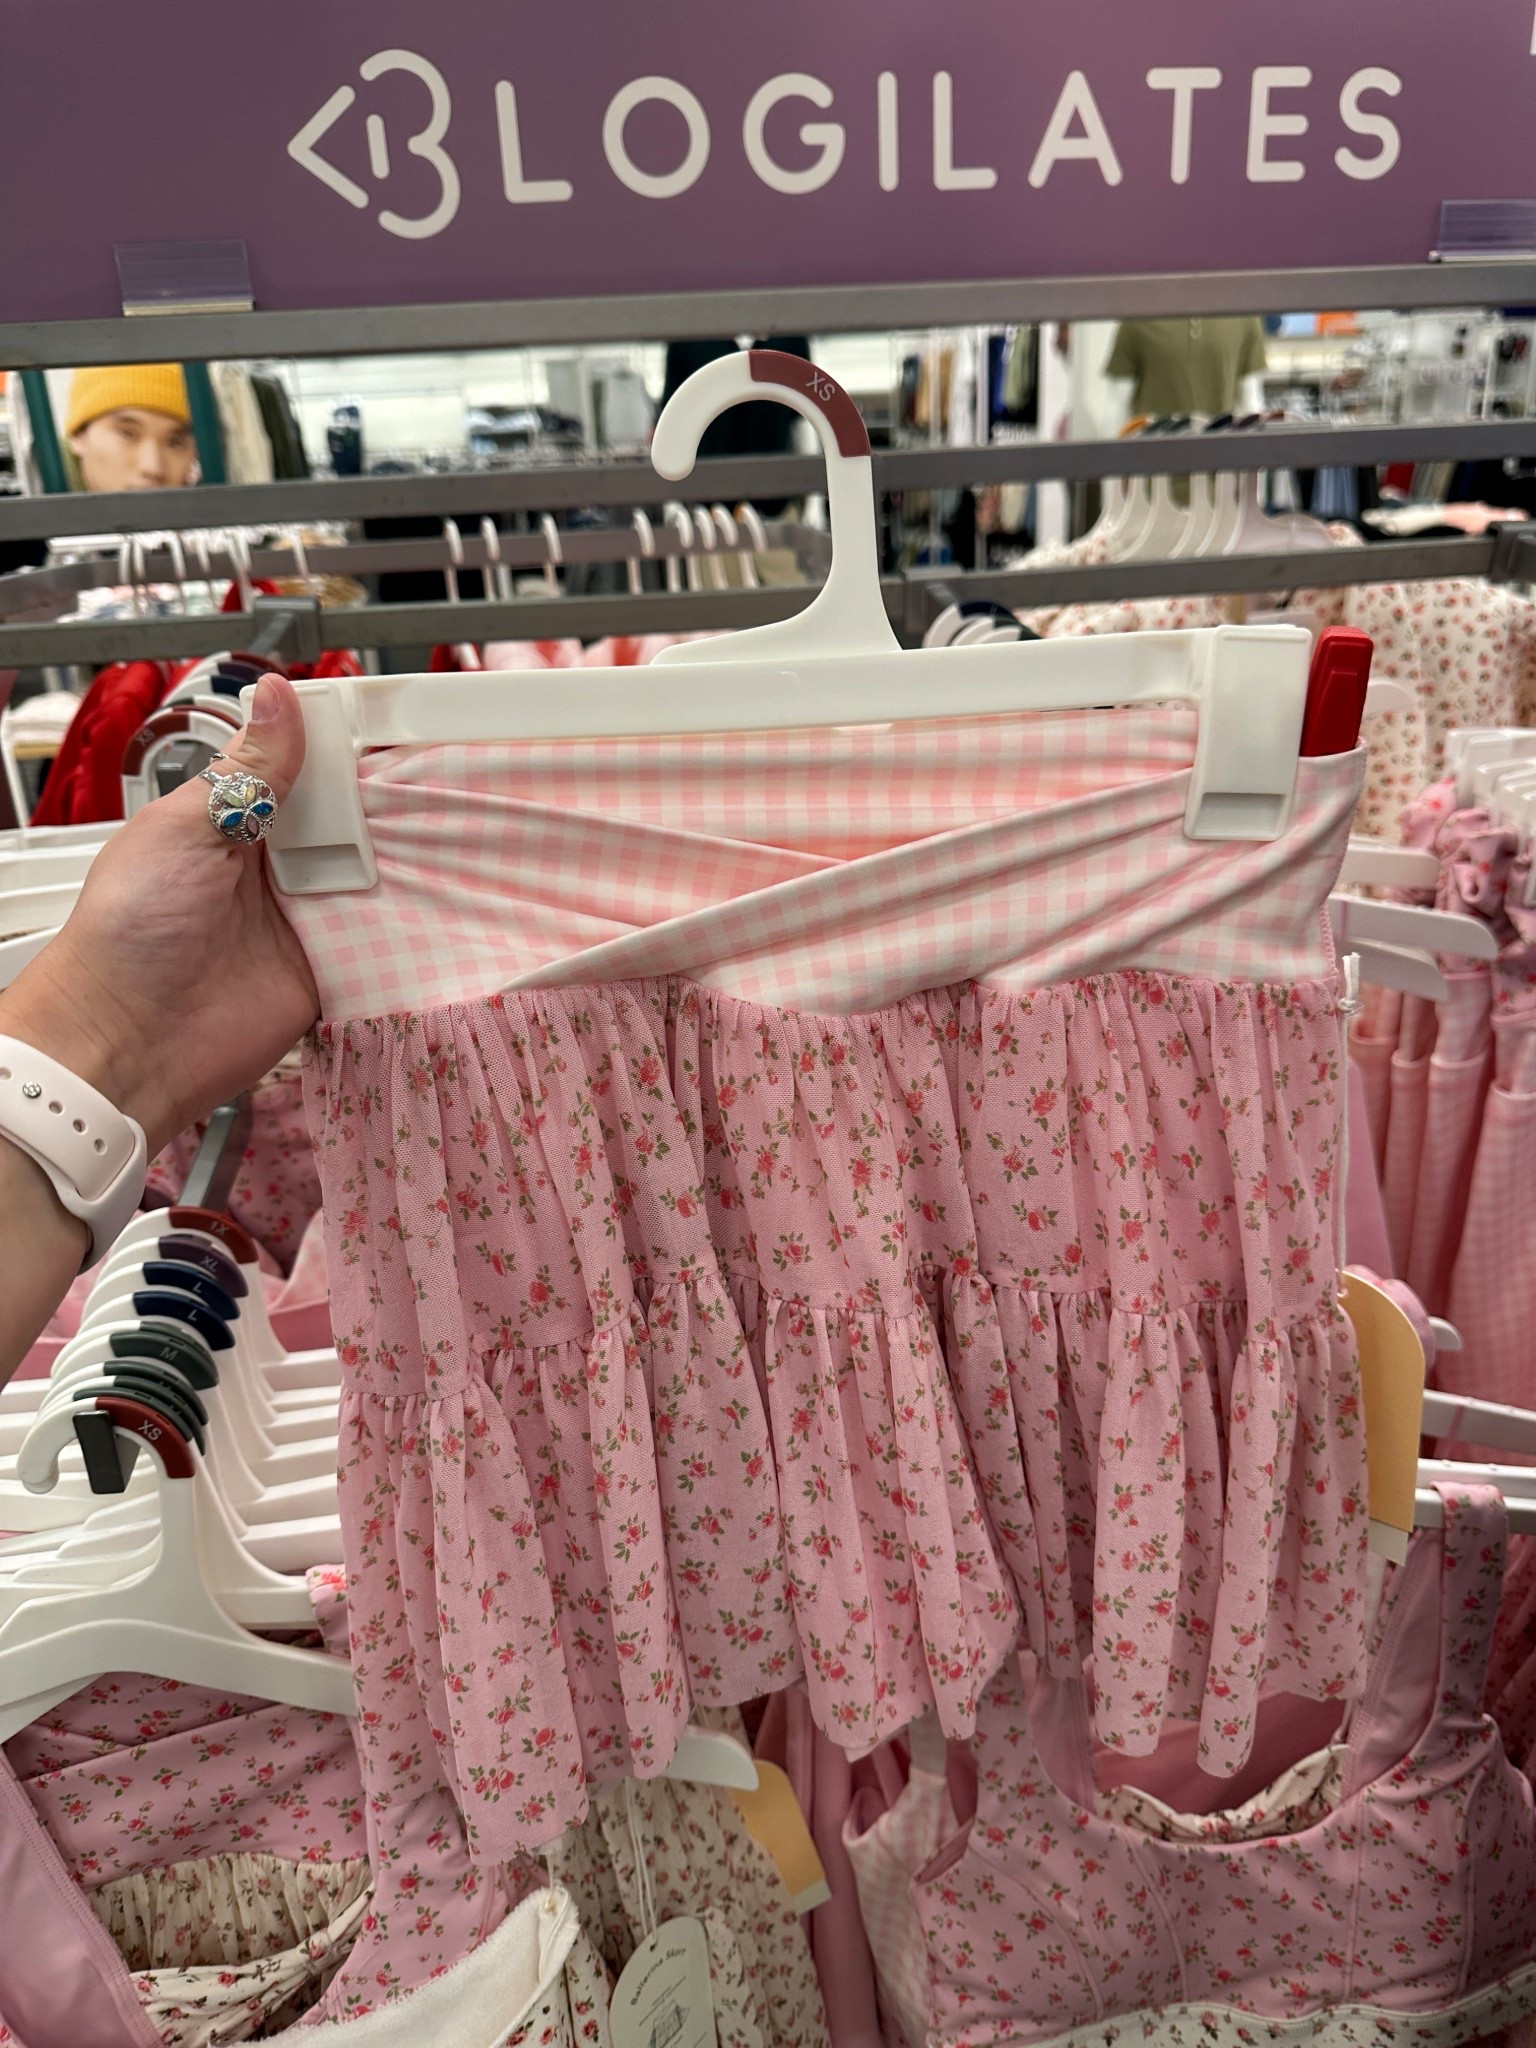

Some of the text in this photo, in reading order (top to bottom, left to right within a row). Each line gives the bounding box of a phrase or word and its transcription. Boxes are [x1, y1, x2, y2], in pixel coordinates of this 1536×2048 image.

[805, 371, 836, 402] XS
[200, 1255, 219, 1273] XL
[192, 1281, 203, 1294] L
[187, 1308, 198, 1322] L
[160, 1346, 179, 1360] M
[137, 1419, 163, 1441] XS
